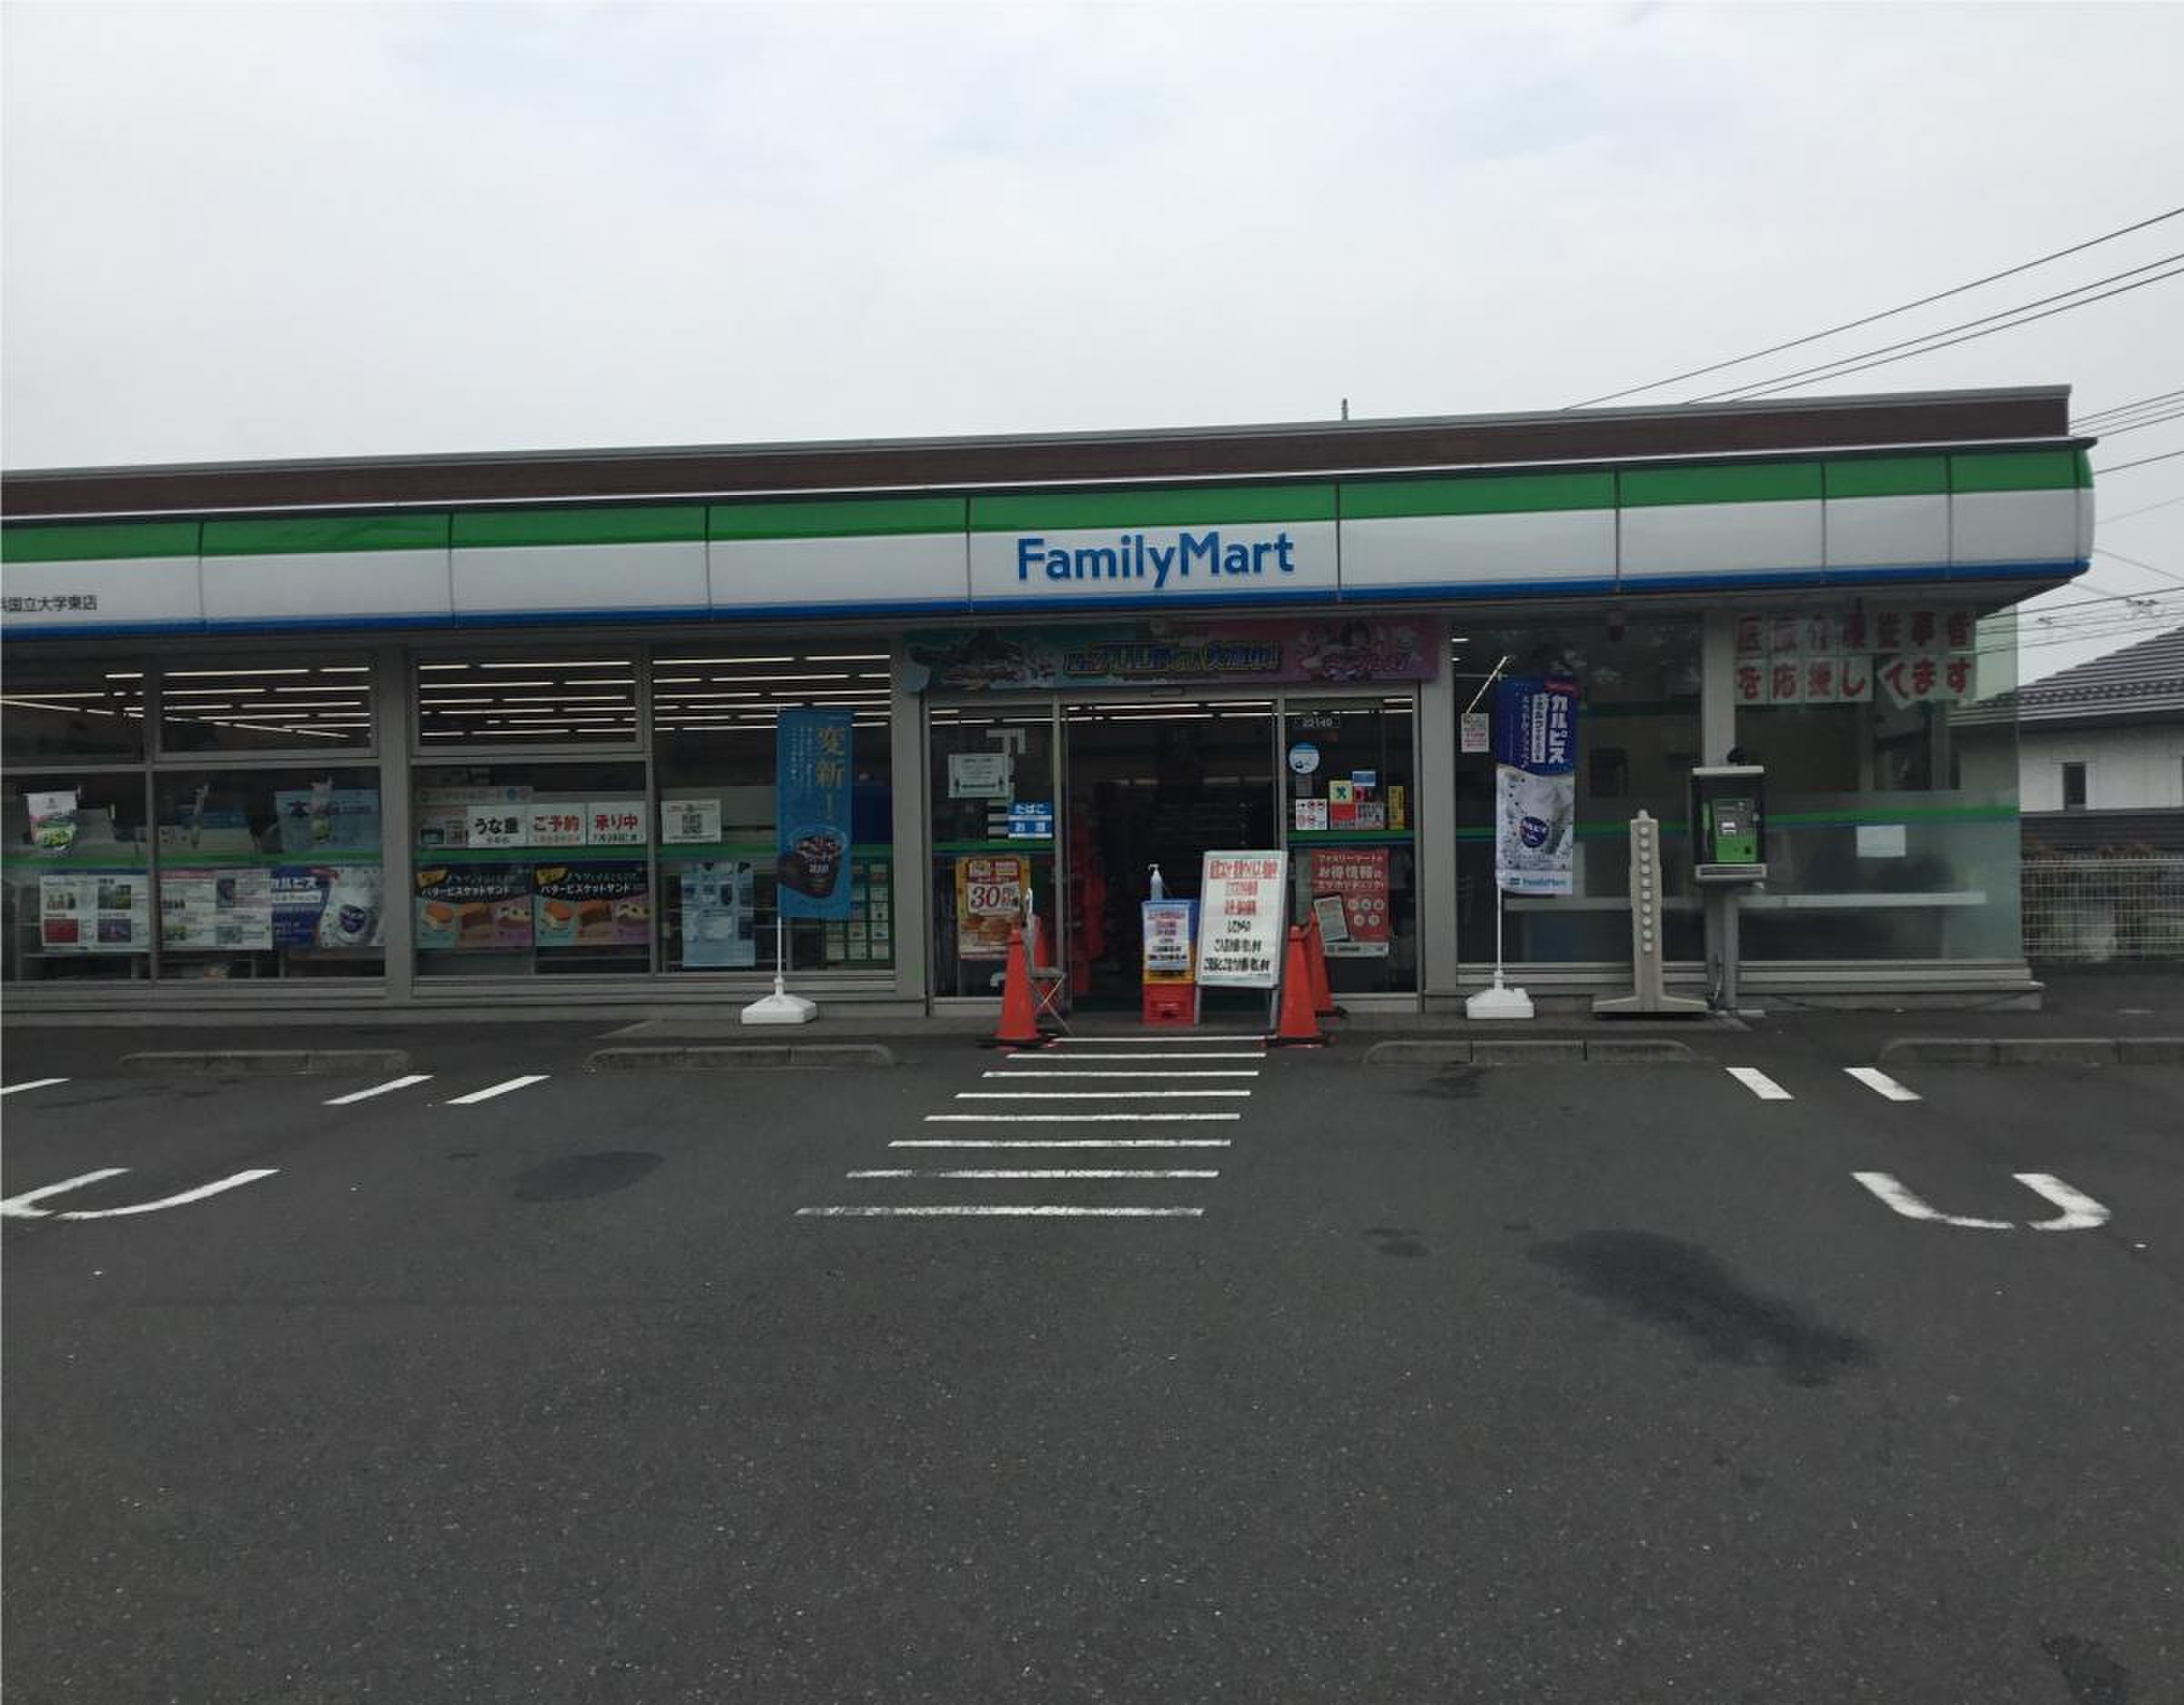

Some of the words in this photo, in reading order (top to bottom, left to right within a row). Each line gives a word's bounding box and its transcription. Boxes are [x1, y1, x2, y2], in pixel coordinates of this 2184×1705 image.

[1017, 531, 1294, 587] FamilyMart
[1548, 694, 1569, 765] カルピス
